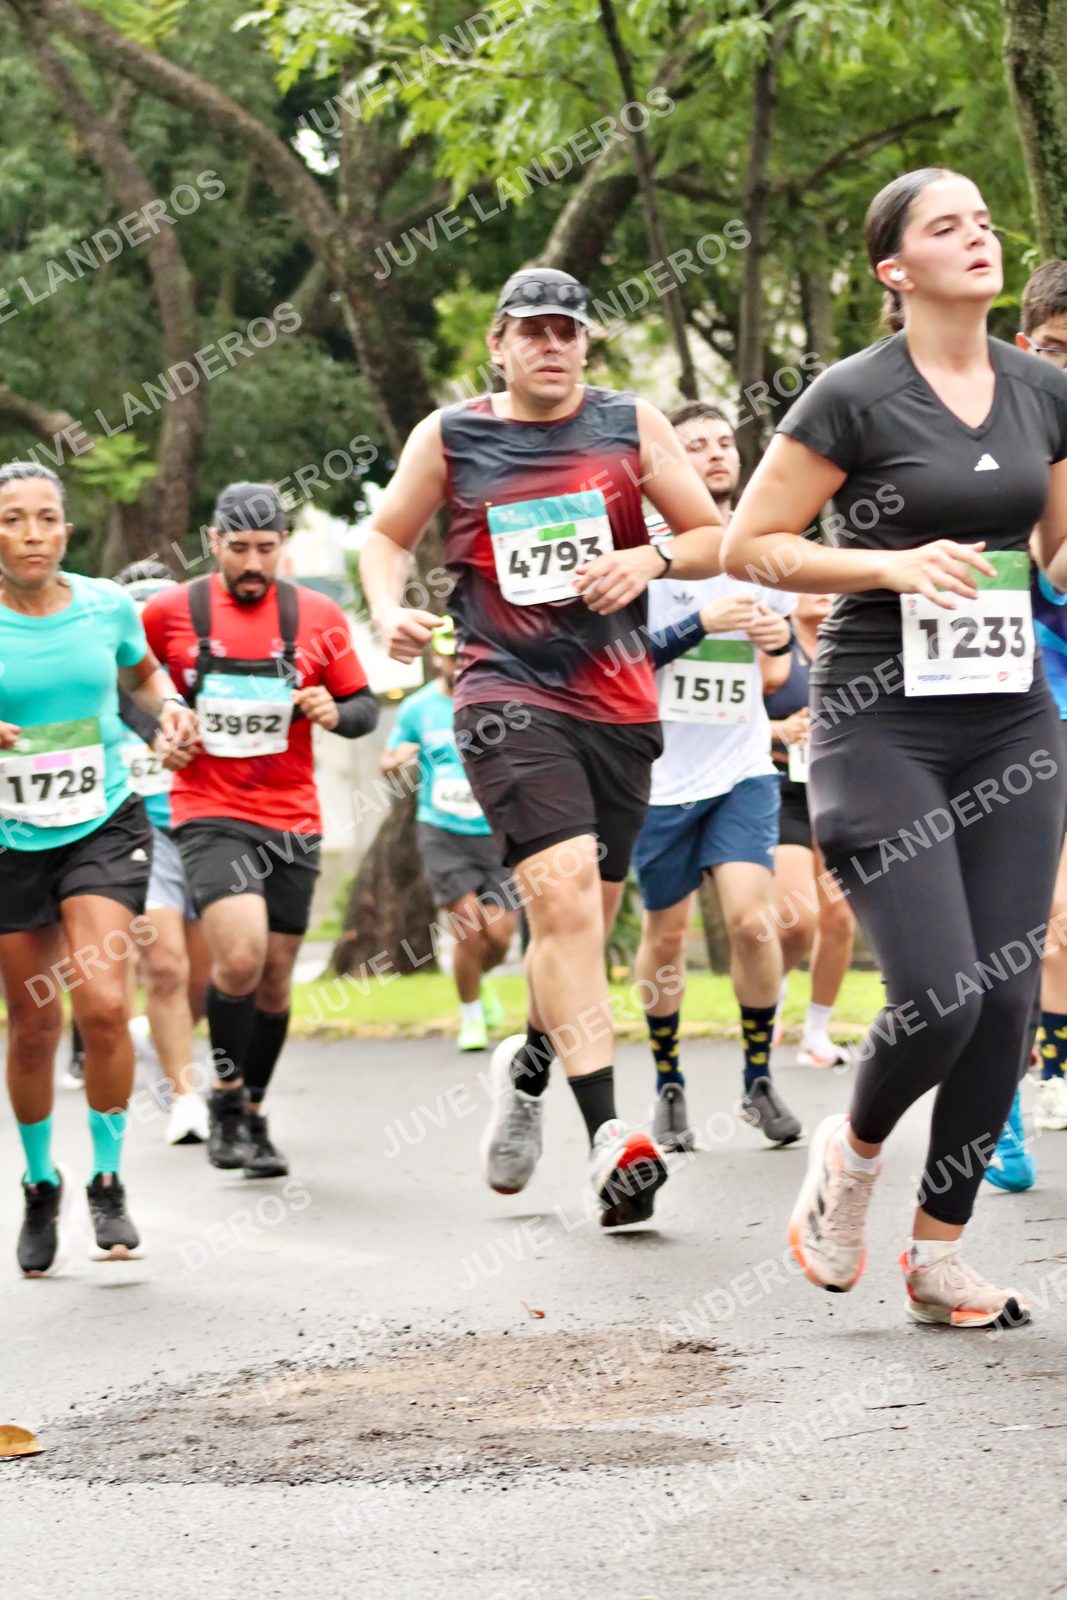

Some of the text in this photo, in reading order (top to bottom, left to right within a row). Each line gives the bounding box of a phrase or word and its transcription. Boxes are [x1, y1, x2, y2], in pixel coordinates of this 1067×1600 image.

[509, 536, 603, 578] 4793
[918, 616, 1026, 660] 1233
[673, 675, 746, 704] 1515
[206, 712, 282, 736] 3962
[7, 765, 96, 804] 1728
